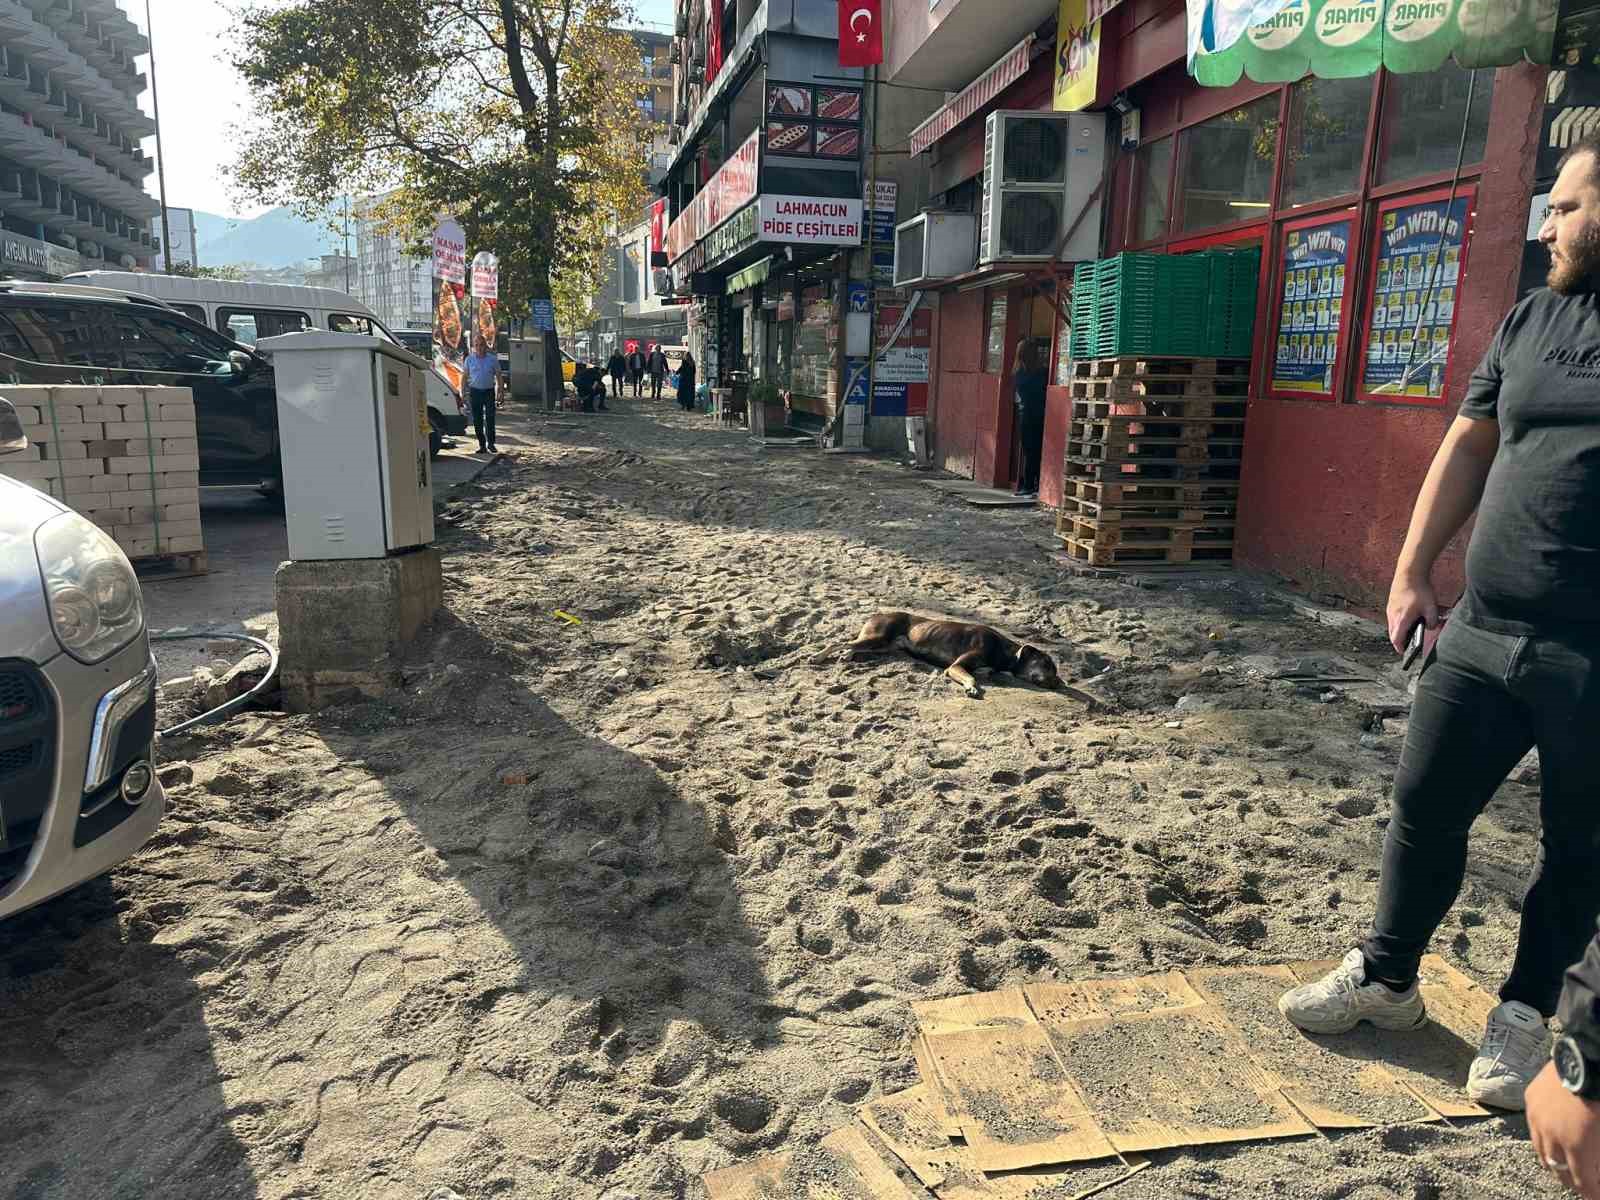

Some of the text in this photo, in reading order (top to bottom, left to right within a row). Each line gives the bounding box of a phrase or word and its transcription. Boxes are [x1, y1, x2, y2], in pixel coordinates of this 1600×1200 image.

[866, 184, 896, 194] AUKAT
[776, 201, 848, 217] LAHMACUN
[763, 218, 792, 234] PİDE
[796, 221, 859, 238] ÇEŞİTLERİ
